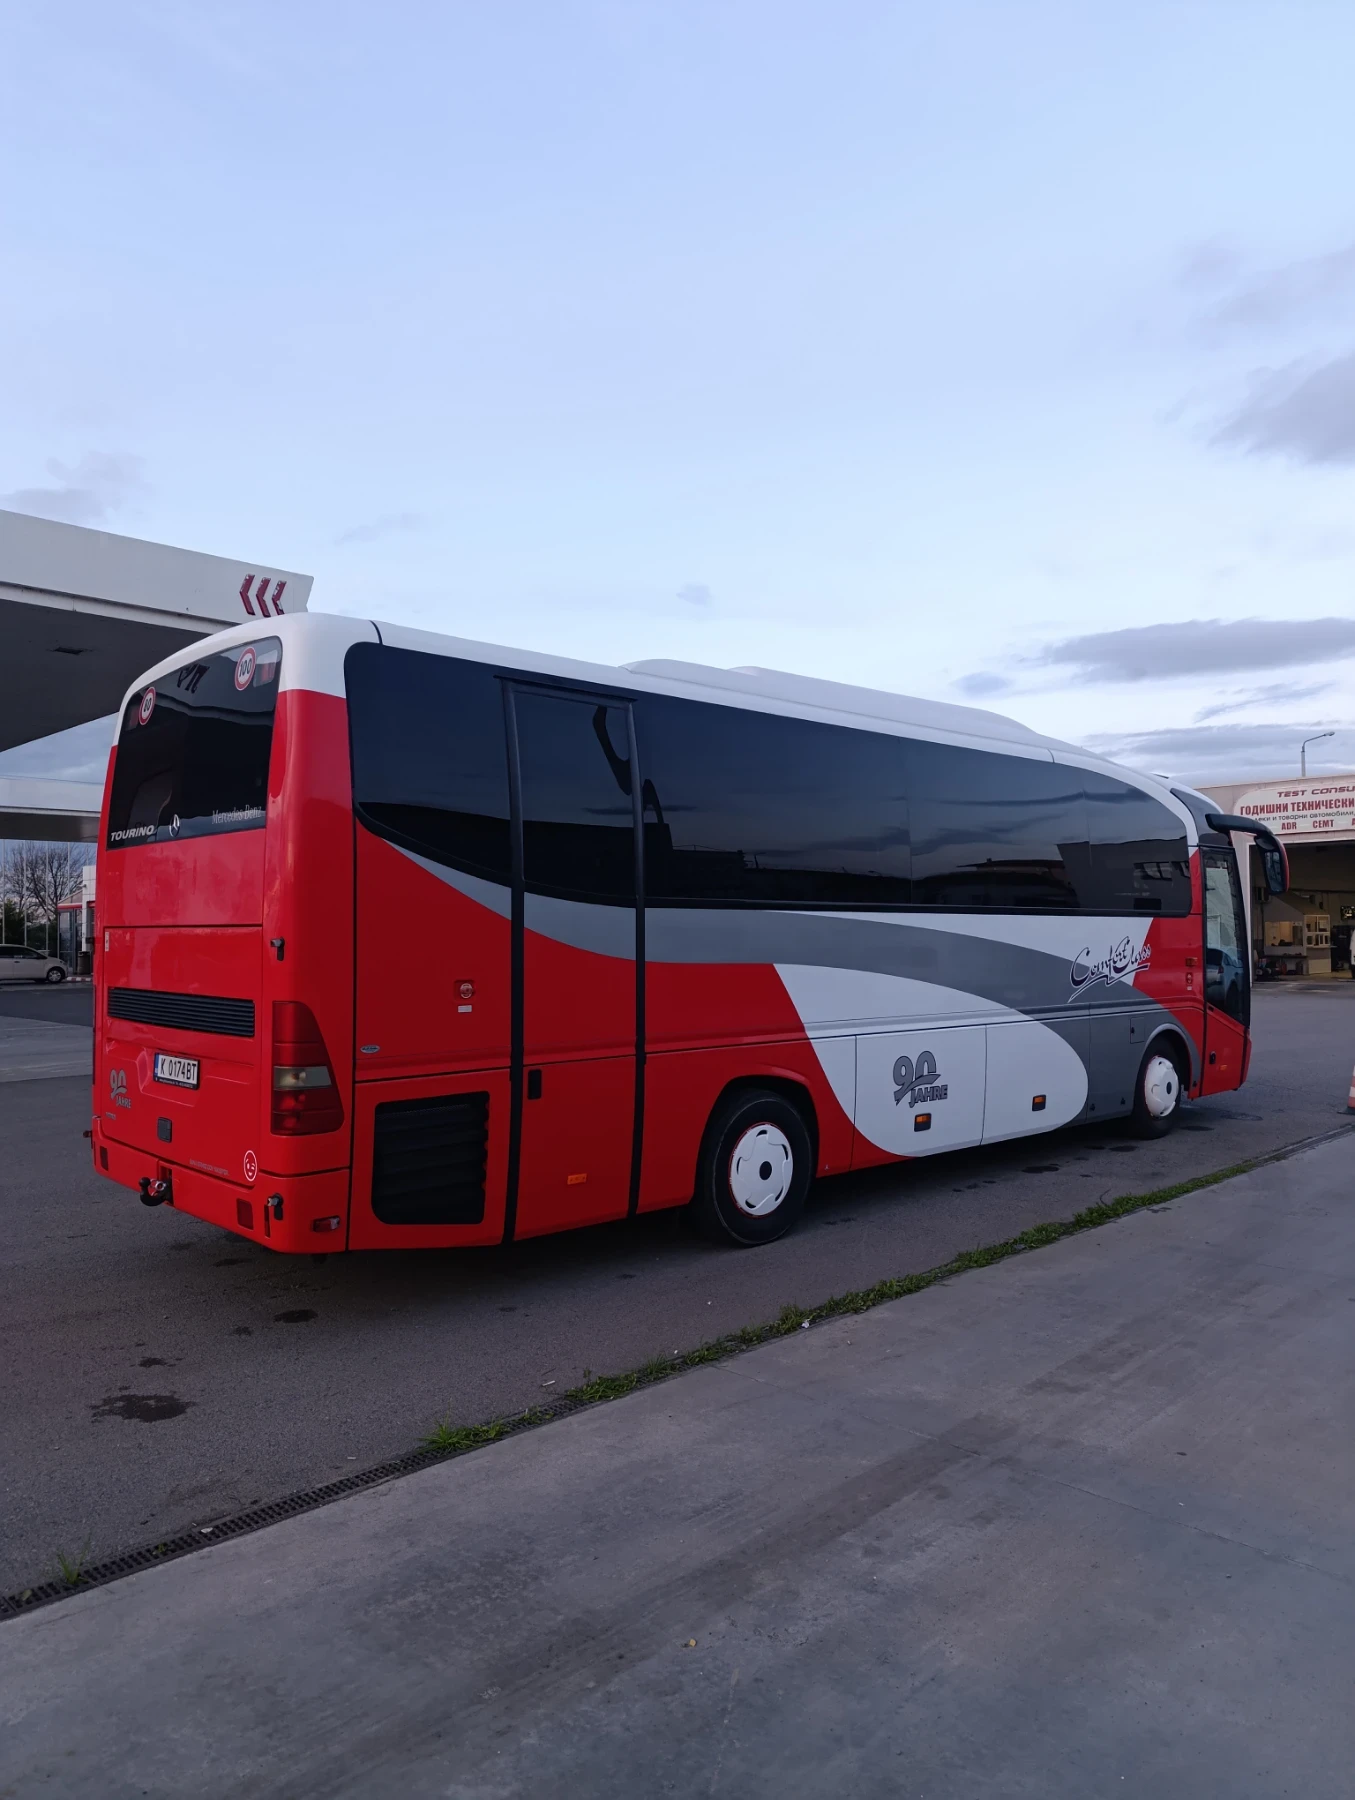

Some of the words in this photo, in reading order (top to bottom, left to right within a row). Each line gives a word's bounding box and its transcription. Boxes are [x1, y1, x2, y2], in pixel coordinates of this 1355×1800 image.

[239, 658, 252, 678] 100
[1277, 789, 1307, 798] TEST
[1240, 803, 1289, 816] ГОДИШНИ
[1290, 798, 1355, 812] ТЕХНИЧЕСКИ
[111, 825, 154, 841] TOURINO
[1281, 821, 1297, 830] ADR
[1312, 819, 1334, 829] CEMT
[110, 1068, 127, 1100] 90
[892, 1050, 941, 1106] 90
[116, 1096, 131, 1109] JAHRE
[908, 1084, 948, 1108] JAHRE
